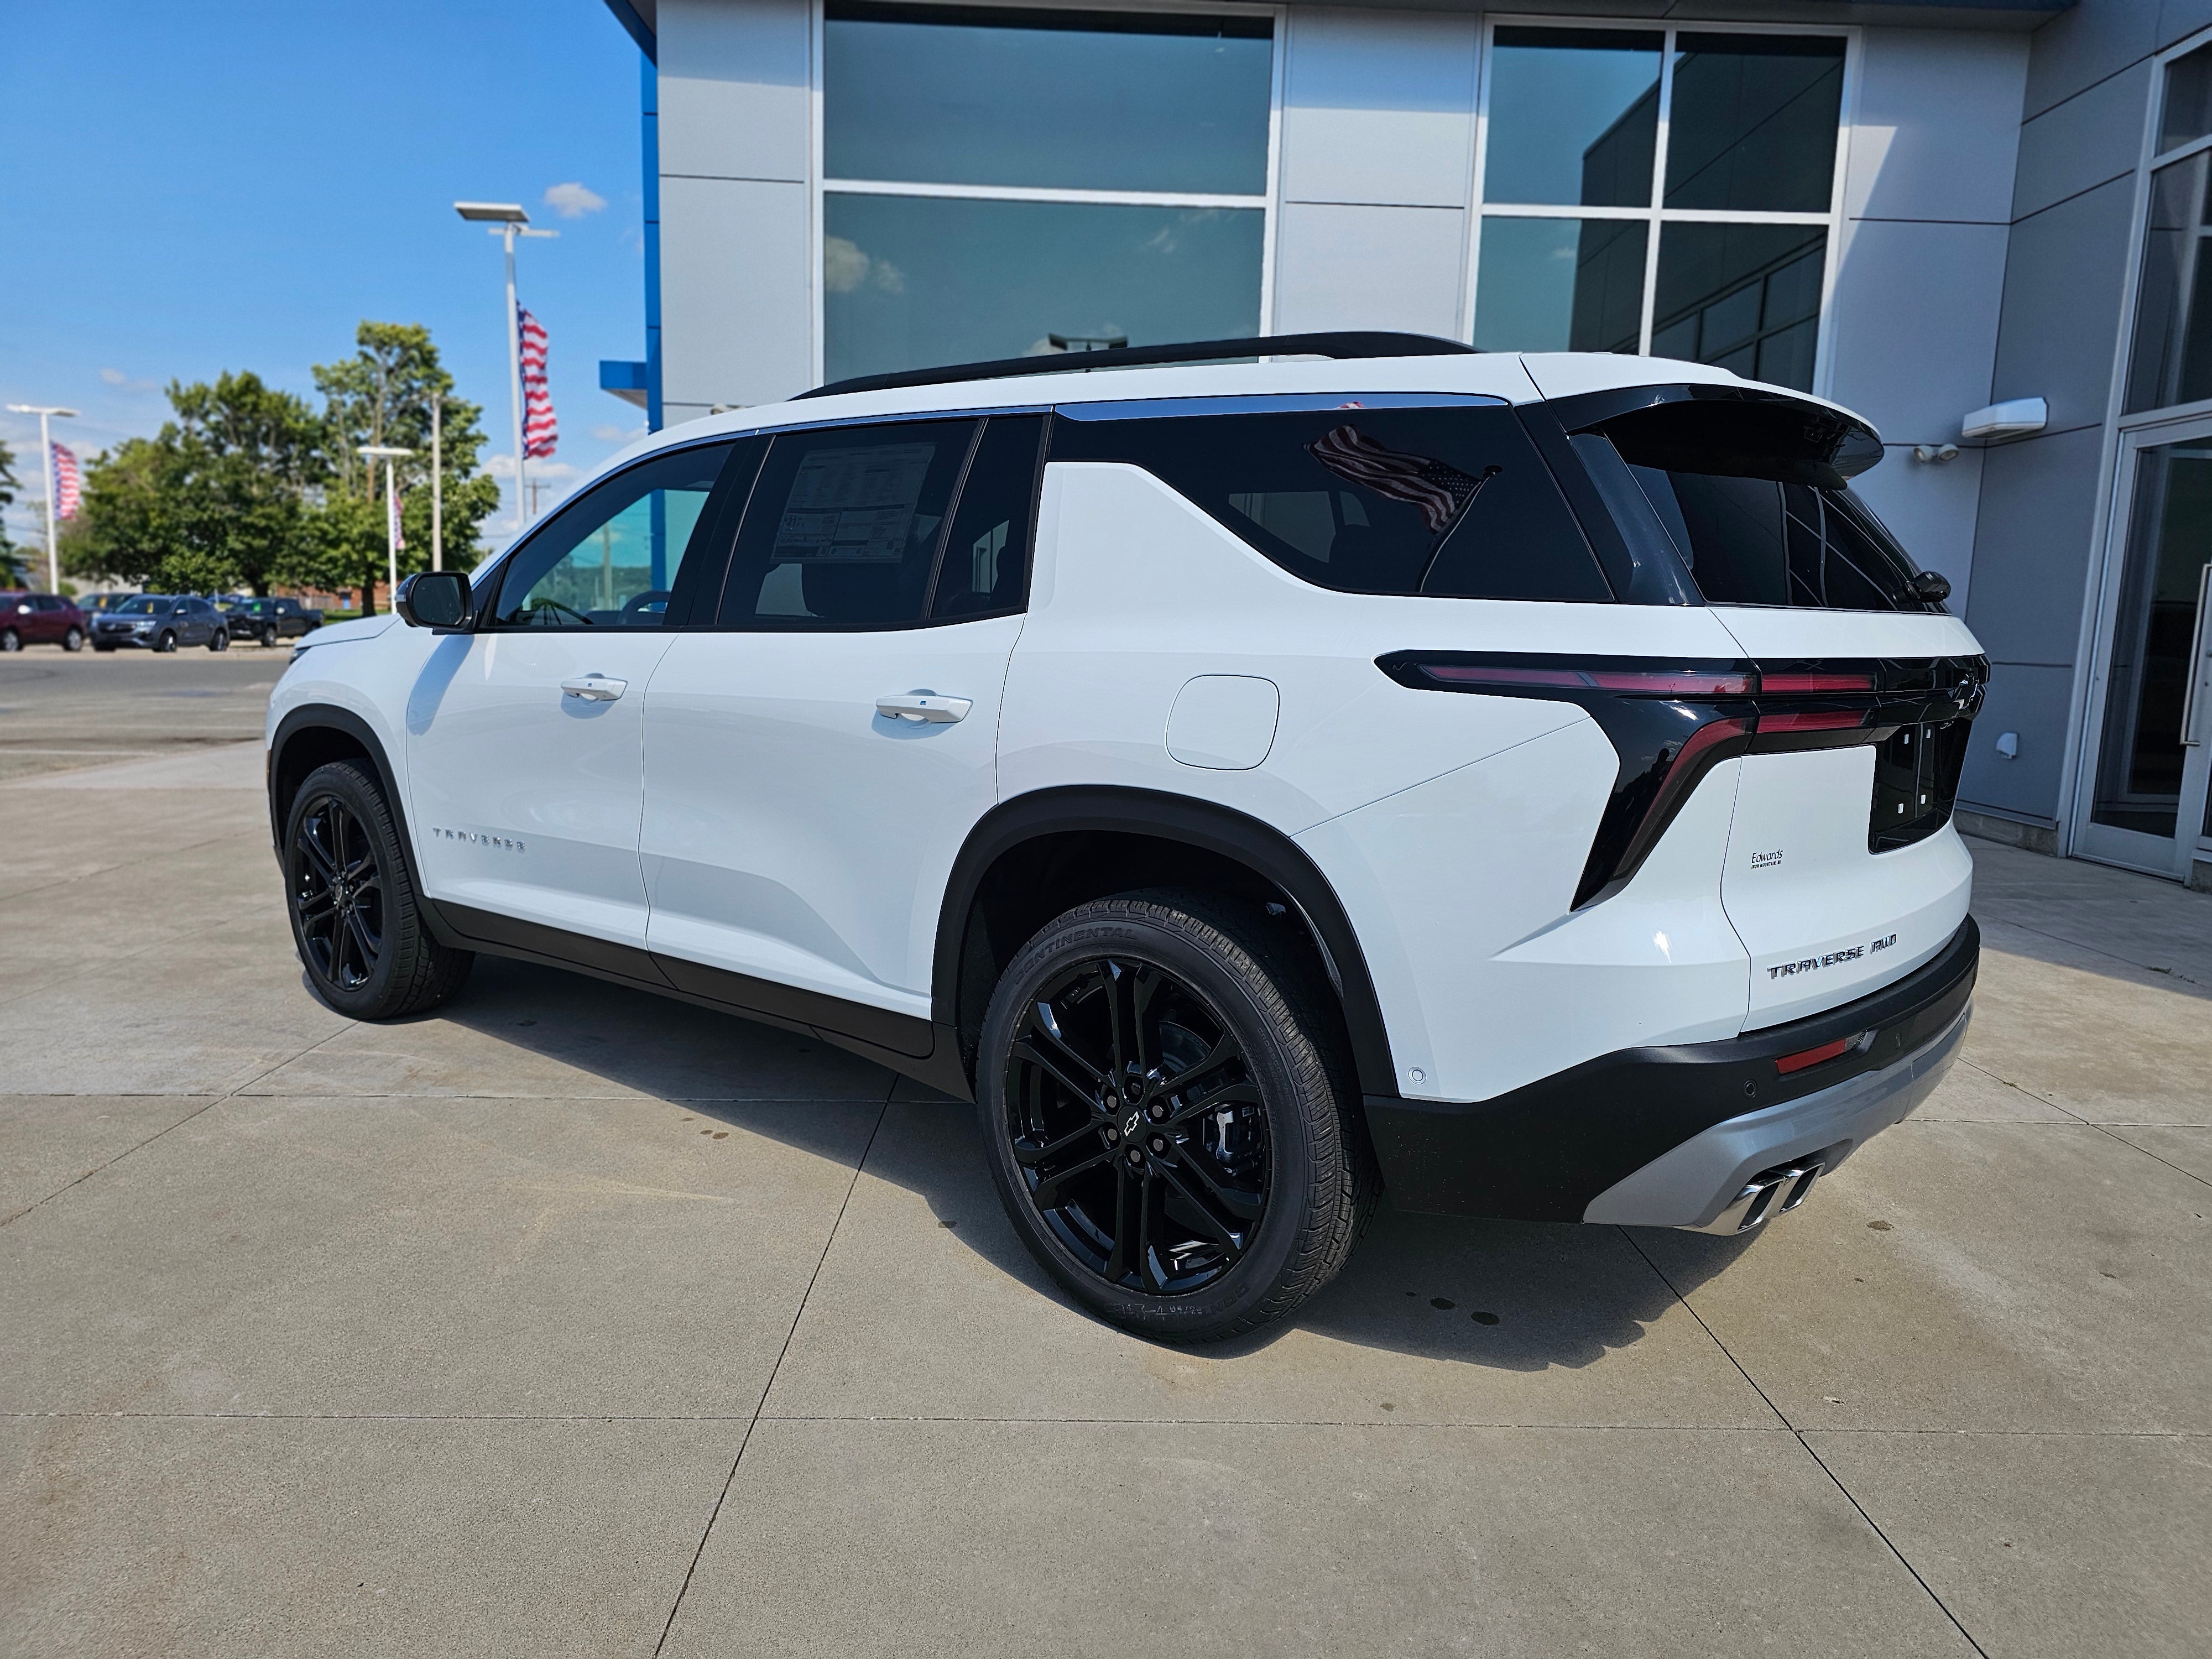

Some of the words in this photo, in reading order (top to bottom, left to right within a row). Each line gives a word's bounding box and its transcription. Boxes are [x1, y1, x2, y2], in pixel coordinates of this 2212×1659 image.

[432, 827, 526, 850] TRAVERSE
[1751, 848, 1783, 863] Edwards
[1014, 926, 1137, 985] CONTINENTAL
[1767, 945, 1865, 979] TRAVERSE
[1870, 933, 1897, 954] AWD
